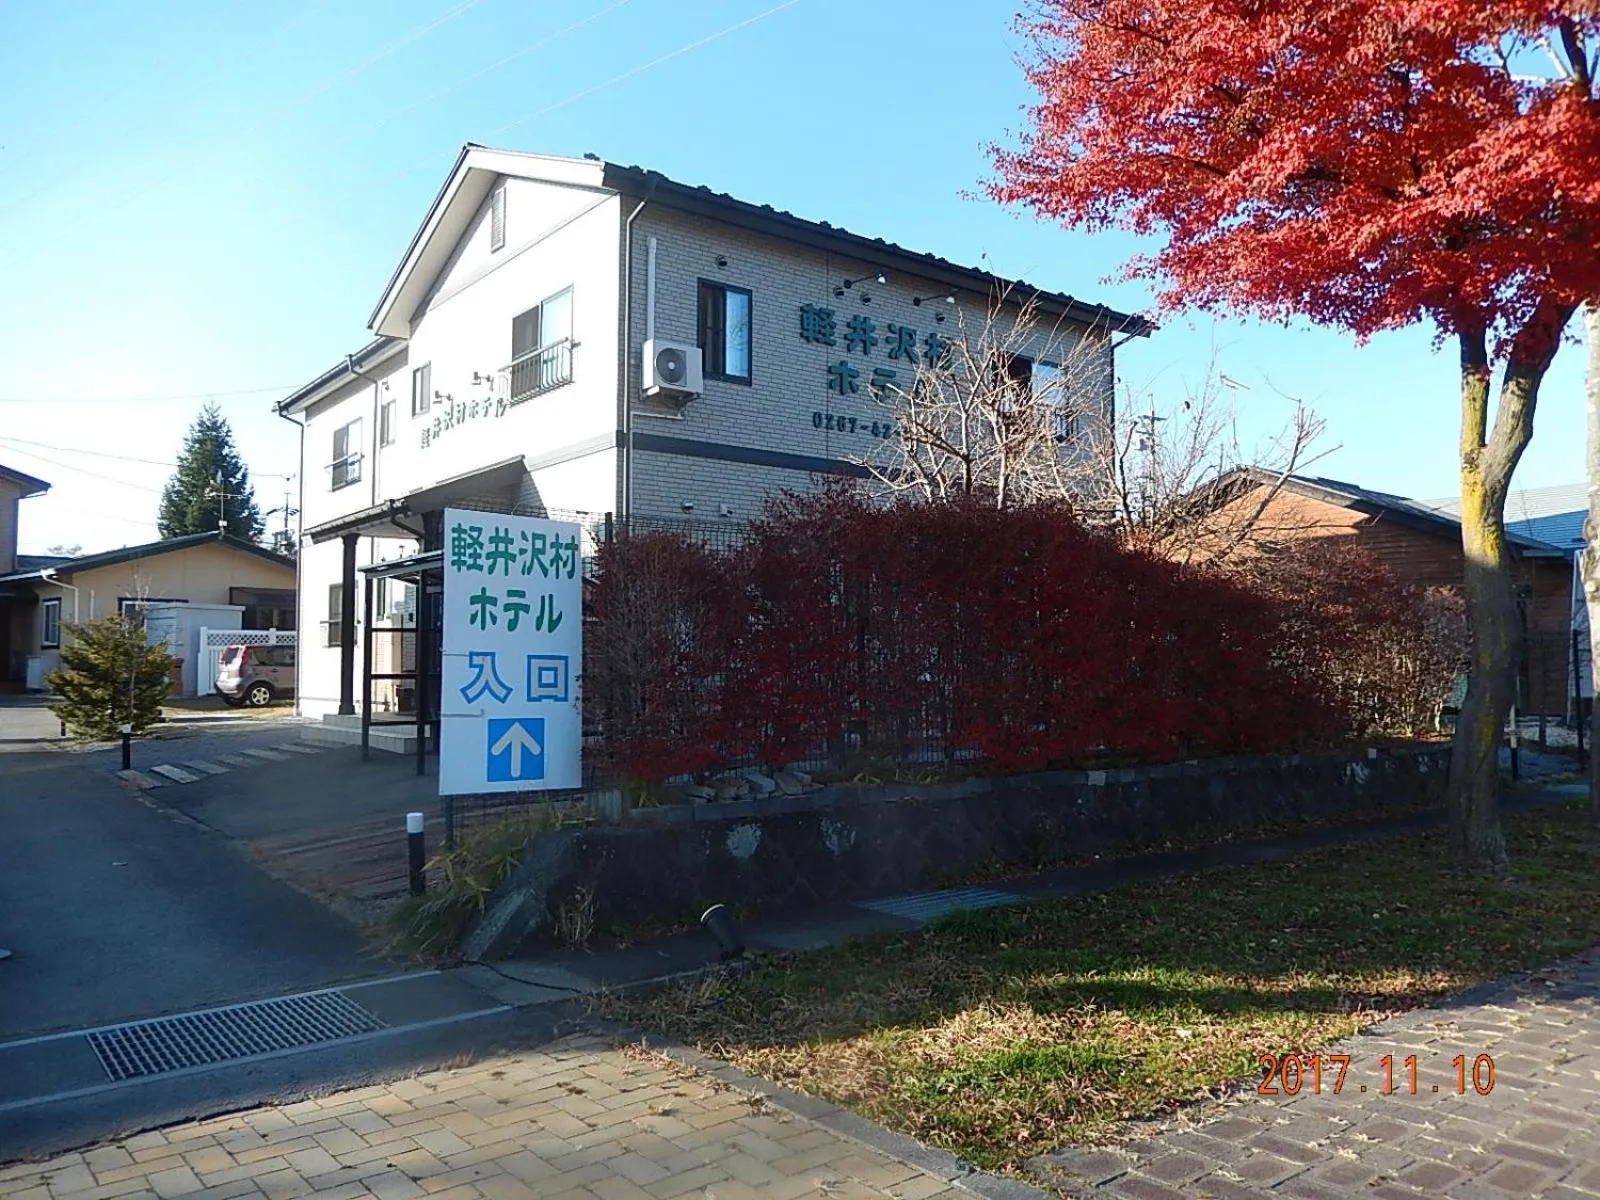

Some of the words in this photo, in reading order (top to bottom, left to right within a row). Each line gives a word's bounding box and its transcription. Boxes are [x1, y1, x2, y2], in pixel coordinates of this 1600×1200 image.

[451, 523, 579, 579] 軽井沢村
[469, 586, 562, 633] ホテル
[460, 651, 569, 704] 入口
